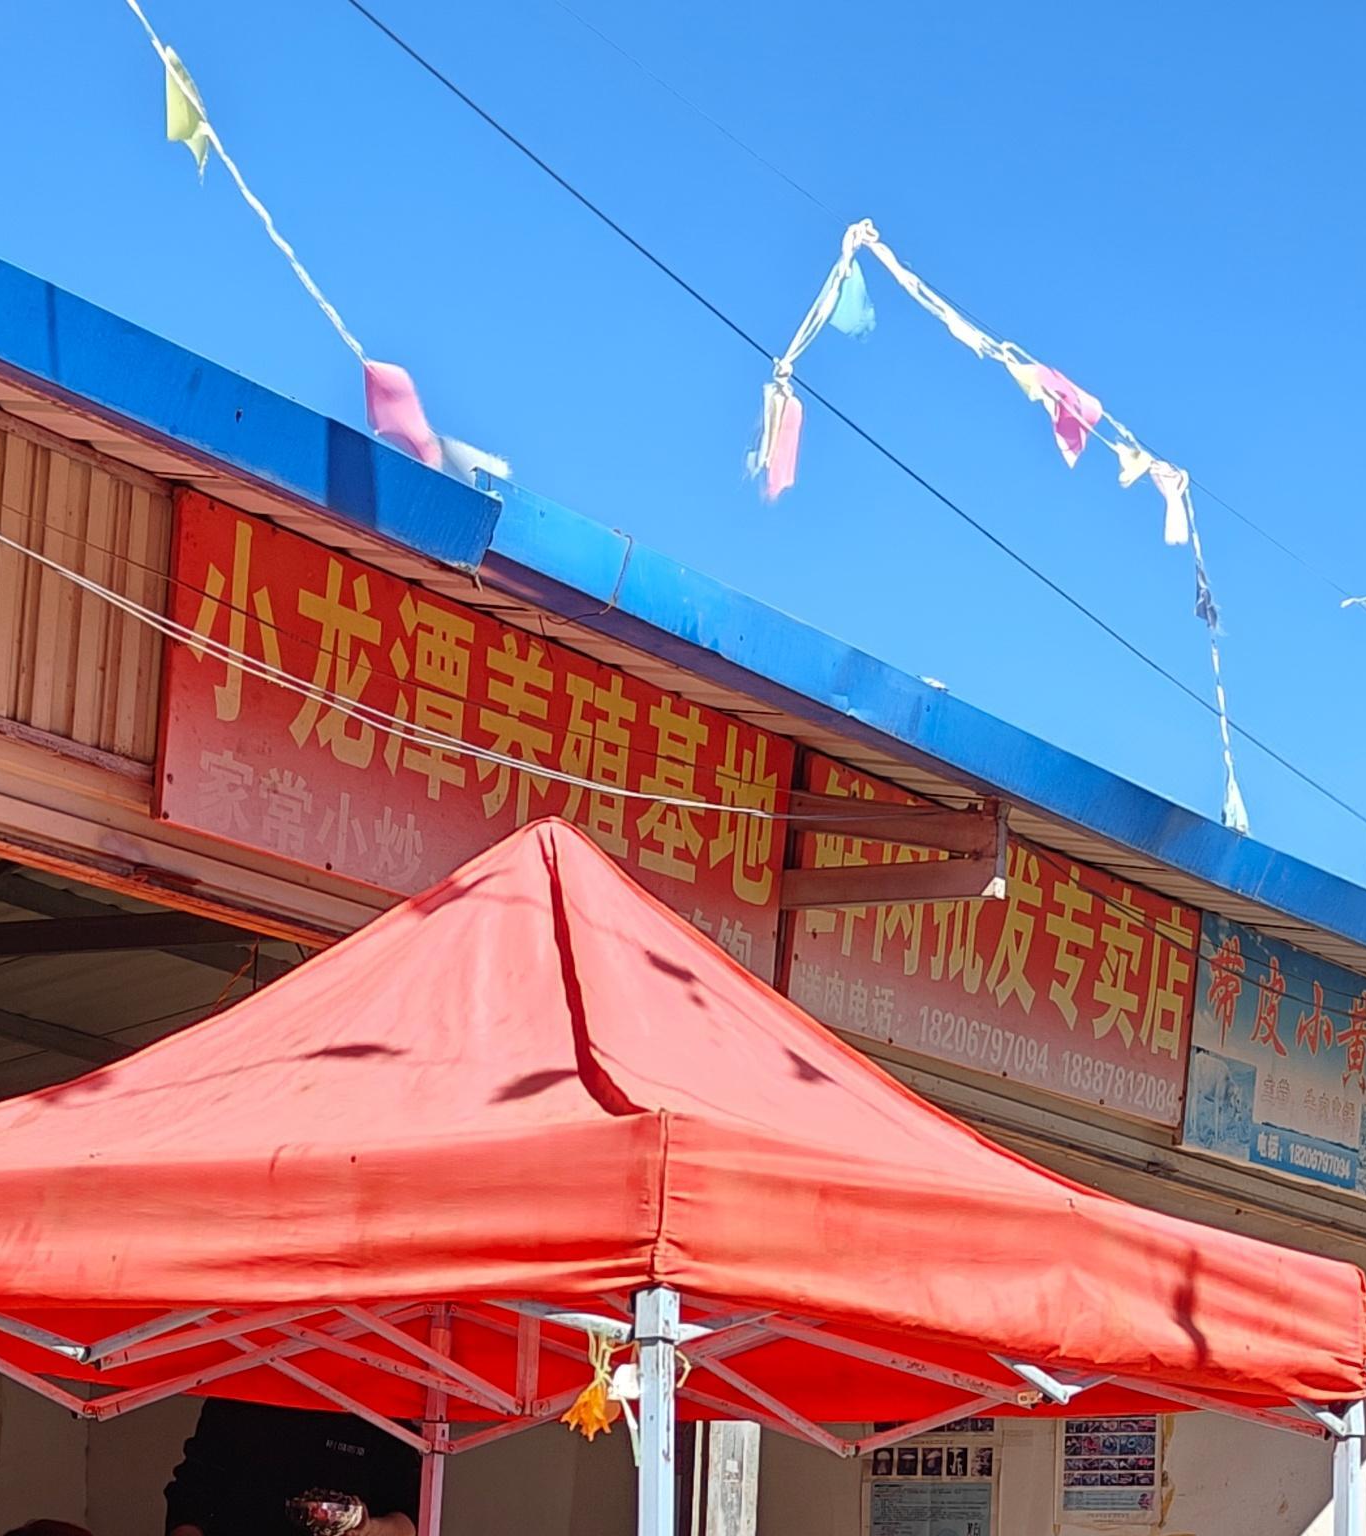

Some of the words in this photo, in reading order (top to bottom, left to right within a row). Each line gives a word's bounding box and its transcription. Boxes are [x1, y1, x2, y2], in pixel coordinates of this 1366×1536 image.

[187, 520, 778, 907] 小龙潭养殖基地
[918, 1004, 1049, 1075] 18206797094
